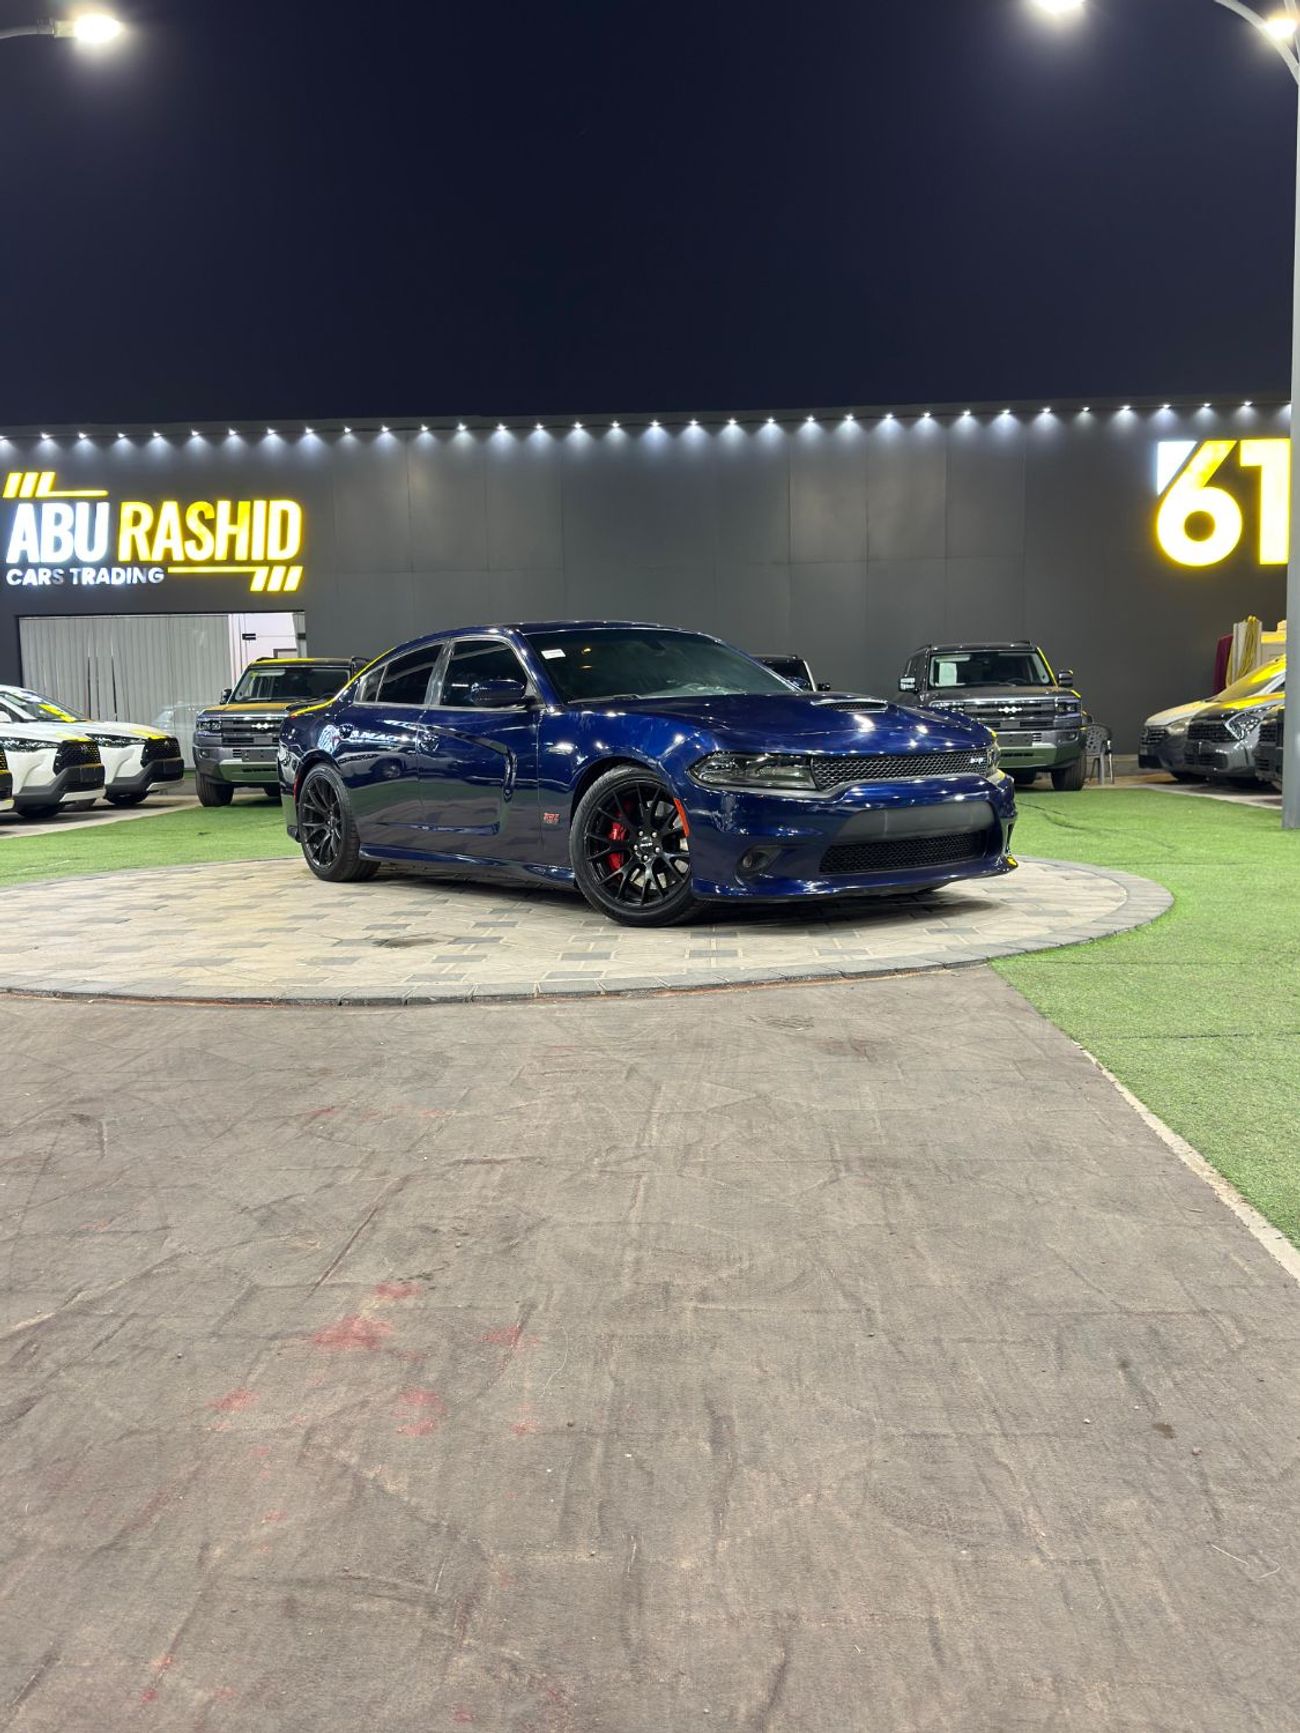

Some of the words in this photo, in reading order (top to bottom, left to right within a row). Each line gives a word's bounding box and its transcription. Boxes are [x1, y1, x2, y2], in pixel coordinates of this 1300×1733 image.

[6, 502, 109, 563] ABU
[118, 500, 302, 561] RASHID
[1156, 438, 1290, 566] 61
[6, 568, 64, 586] CARS
[70, 567, 165, 585] TRADING
